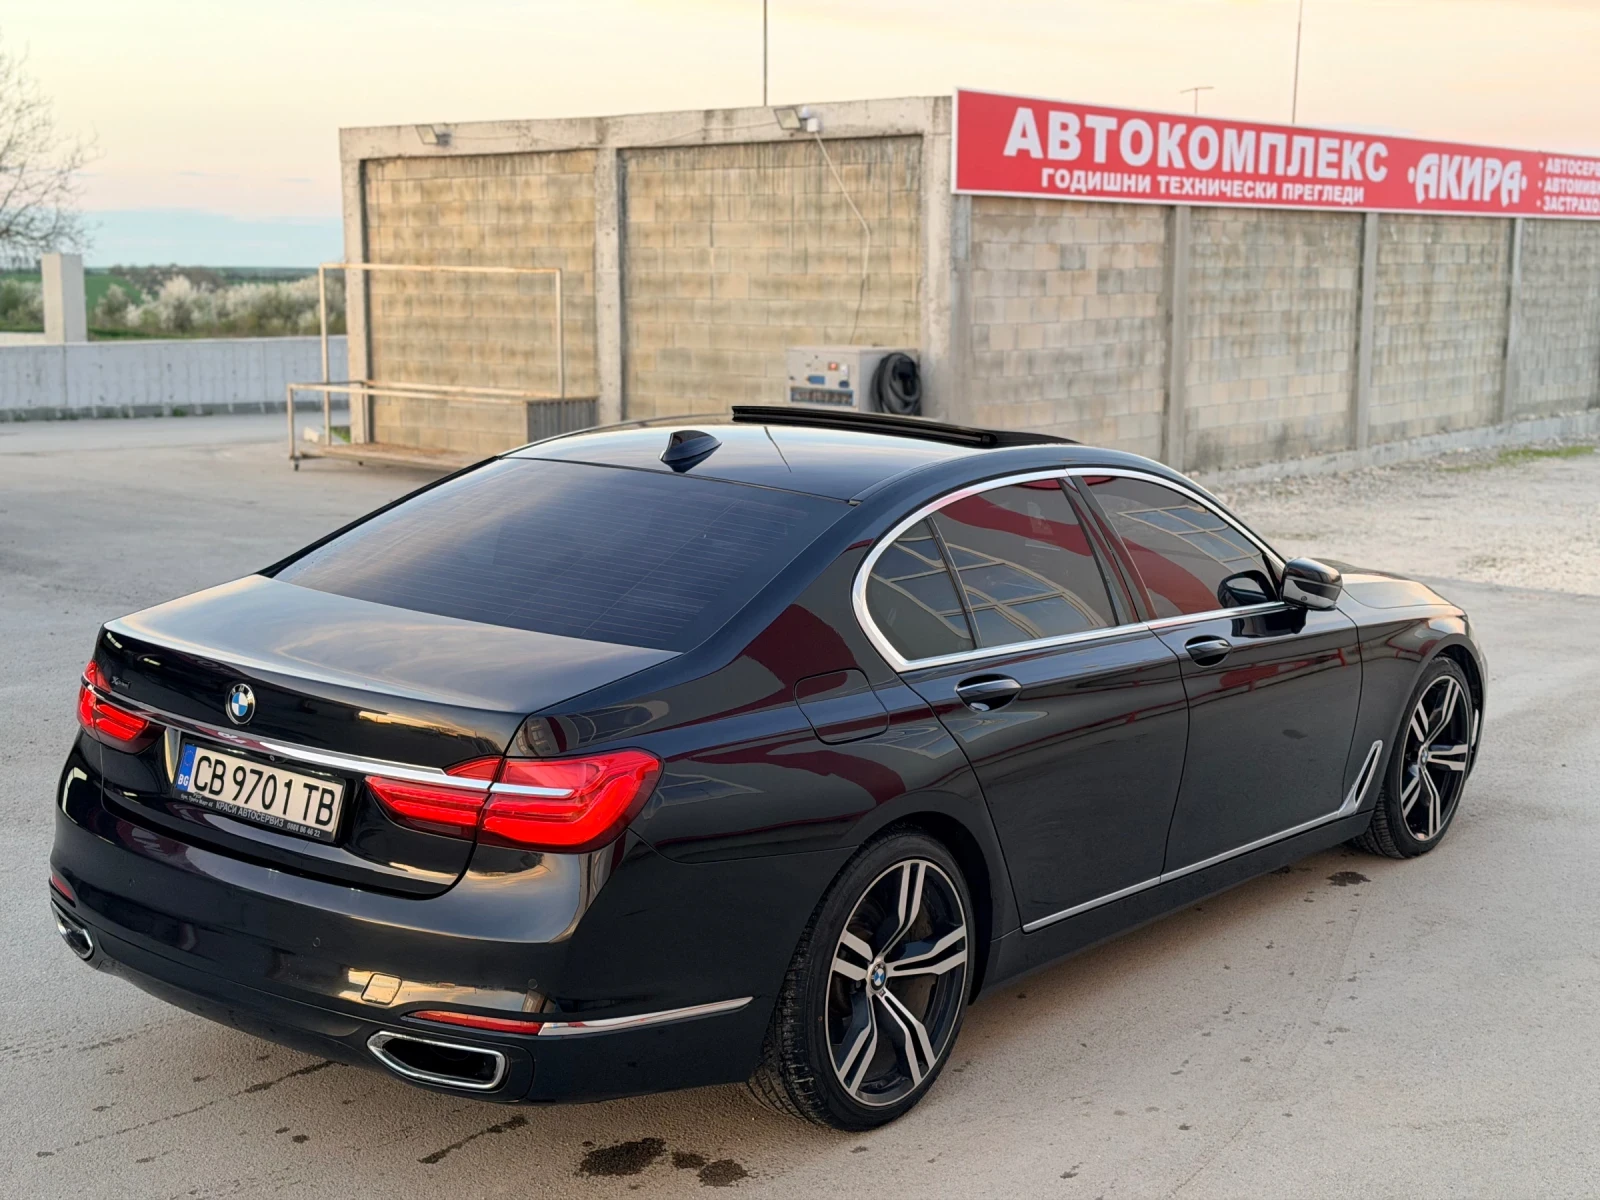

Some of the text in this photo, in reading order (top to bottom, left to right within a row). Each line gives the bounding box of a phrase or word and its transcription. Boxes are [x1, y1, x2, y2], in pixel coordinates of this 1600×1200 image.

[1003, 106, 1388, 183] АВТОКОМПЛЕКС
[1041, 167, 1365, 206] ГОДИШНИ ТЕХНИЧЕСКИ ПРЕГЛЕДИ
[1415, 152, 1522, 208] АКИРА
[177, 773, 190, 787] BG
[193, 755, 335, 827] CB 9701 TB
[215, 801, 238, 815] КРАСИ
[237, 807, 284, 828] АВТОСЕРВИЗ
